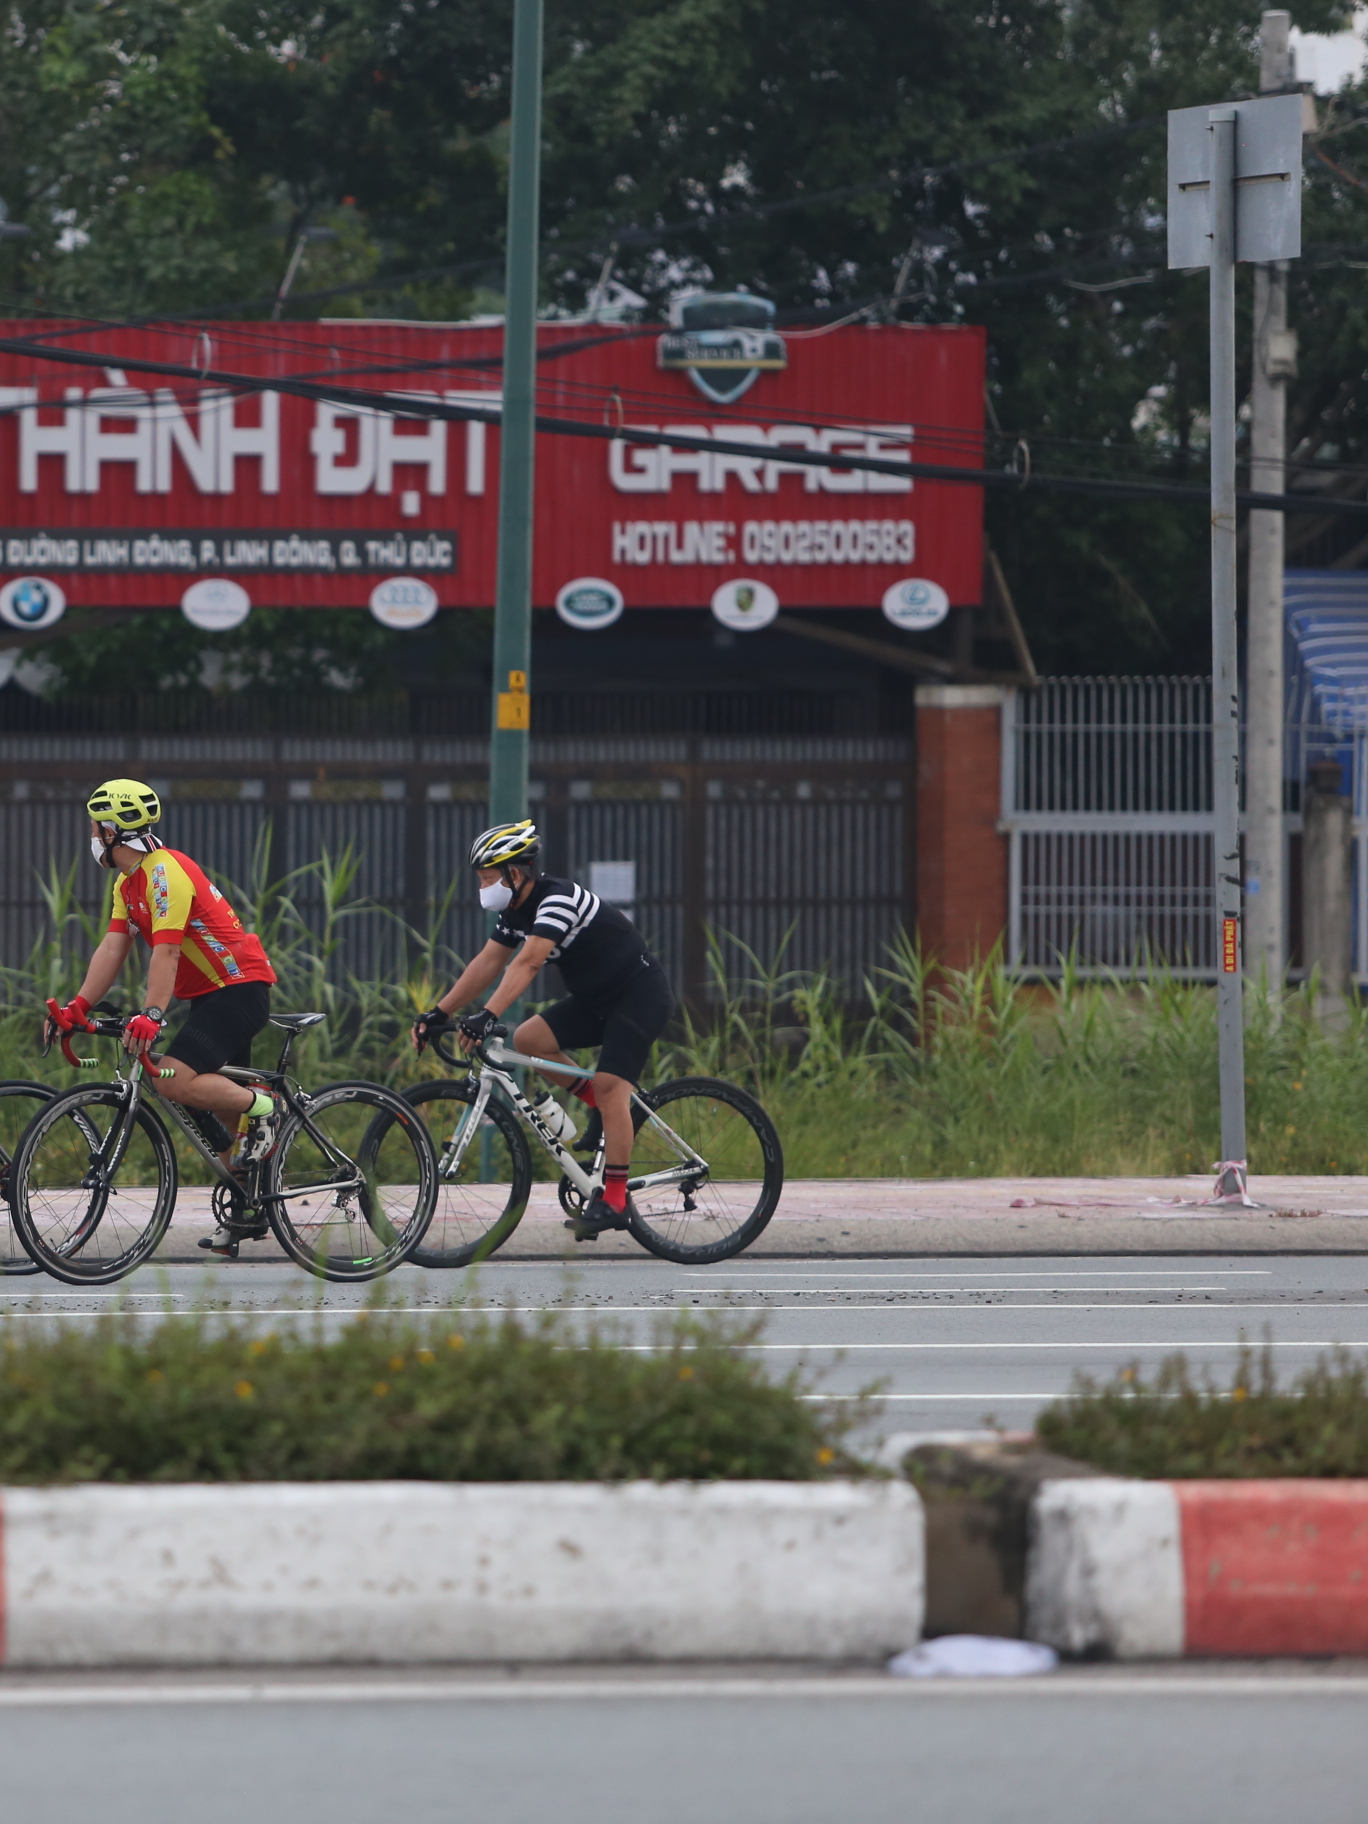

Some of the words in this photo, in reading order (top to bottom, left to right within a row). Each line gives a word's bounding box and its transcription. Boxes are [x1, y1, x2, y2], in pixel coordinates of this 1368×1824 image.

[309, 389, 503, 517] ĐẠT
[608, 423, 915, 494] GARAGE
[83, 538, 130, 567] LINH
[199, 539, 220, 566] P.
[223, 538, 269, 567] LINH
[612, 520, 736, 565] HOTLINE:
[741, 519, 916, 565] 0902500583
[512, 1092, 568, 1158] TREK
